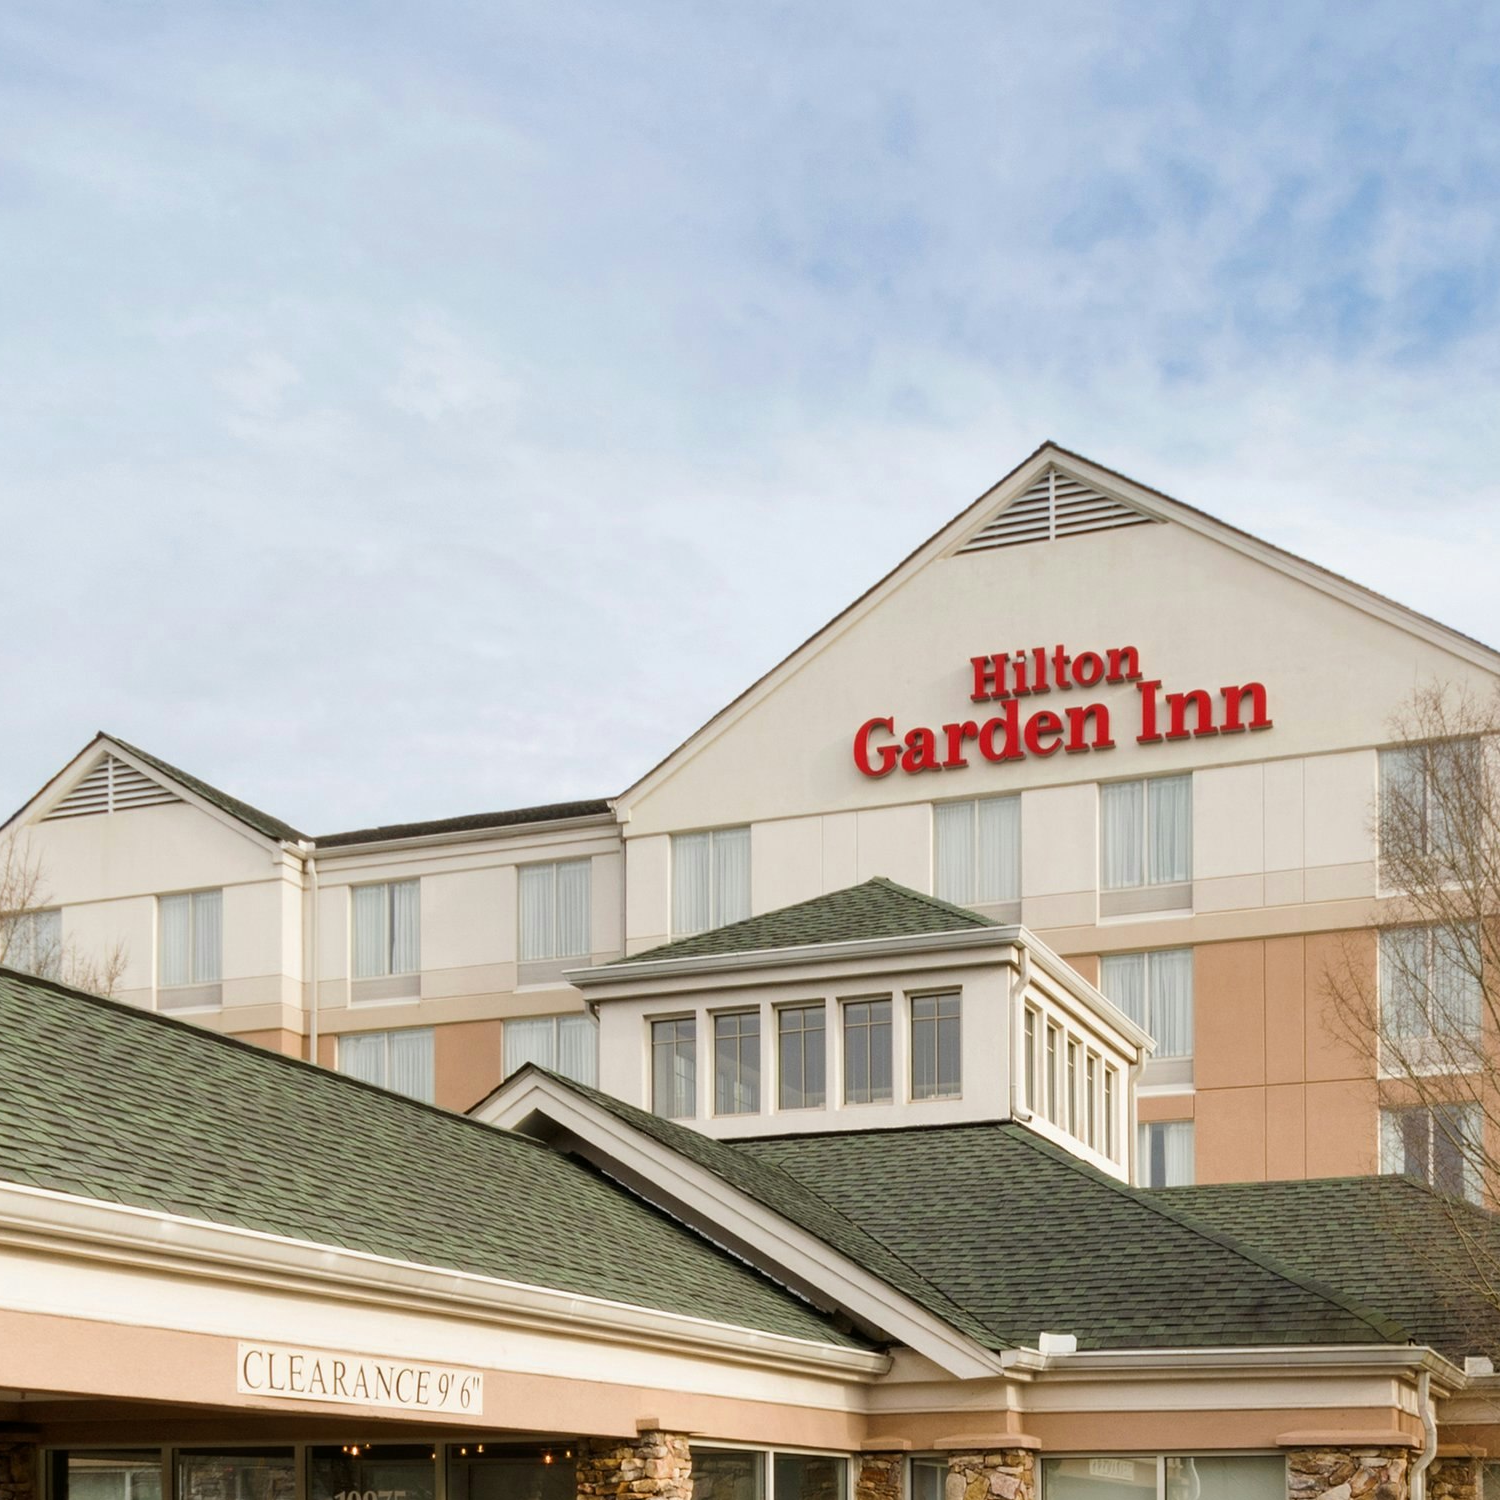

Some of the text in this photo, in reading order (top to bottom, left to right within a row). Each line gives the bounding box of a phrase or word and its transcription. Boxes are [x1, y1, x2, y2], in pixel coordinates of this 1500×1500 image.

[969, 643, 1143, 702] Hilton
[853, 679, 1274, 778] Garden Inn
[243, 1350, 431, 1405] CLEARANCE
